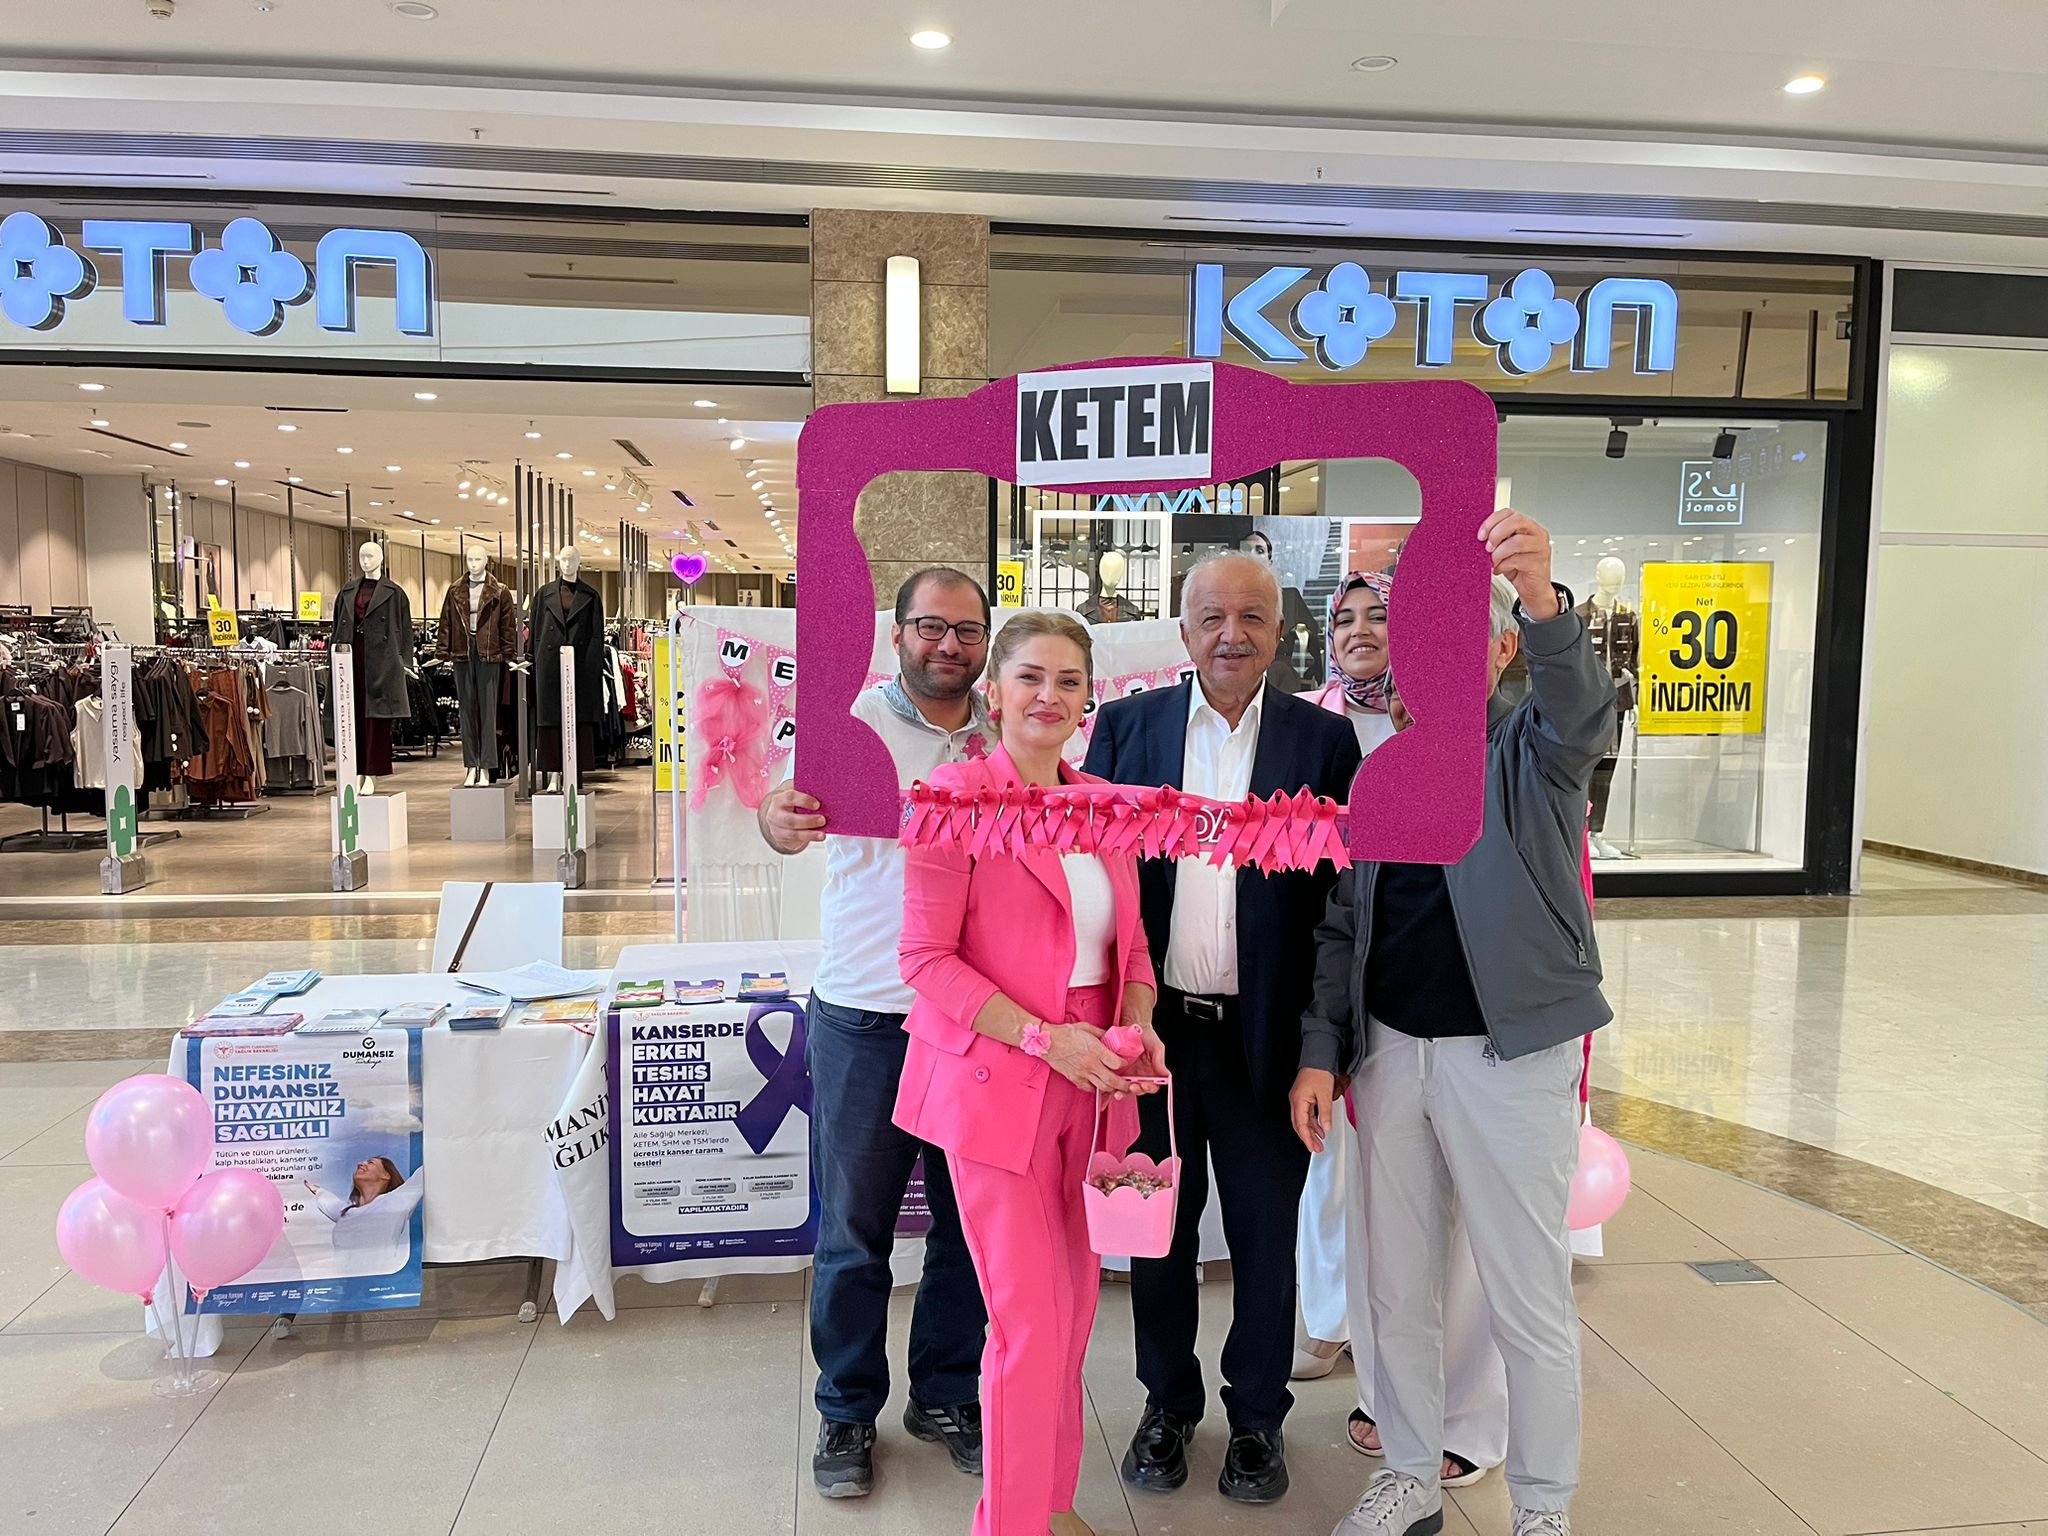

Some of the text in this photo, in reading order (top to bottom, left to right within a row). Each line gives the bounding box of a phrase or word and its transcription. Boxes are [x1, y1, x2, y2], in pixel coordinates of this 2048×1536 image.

[1189, 262, 1678, 375] KOTON
[1020, 381, 1211, 462] KETEM
[1696, 598, 1714, 606] Net
[1651, 674, 1751, 712] İNDİRİM
[632, 1023, 744, 1040] KANSERDE
[343, 1050, 394, 1059] DUMANSIZ
[634, 1043, 702, 1061] ERKEN
[634, 1065, 708, 1082] TEŞHİS
[214, 1083, 339, 1101] DUMANSIZ
[634, 1085, 704, 1103] HAYAT
[217, 1100, 342, 1121] HAYATINIZ
[634, 1104, 738, 1124] KURTARIR
[633, 1131, 648, 1139] Aile
[650, 1130, 676, 1139] Sağlığı
[633, 1149, 665, 1157] ücretsiz
[667, 1147, 694, 1156] kanser
[215, 1159, 232, 1169] kalp
[280, 1155, 306, 1163] kanser
[271, 1163, 306, 1172] sorunları
[308, 1162, 323, 1171] gibi
[633, 1159, 662, 1167] testleri
[291, 1203, 305, 1211] de
